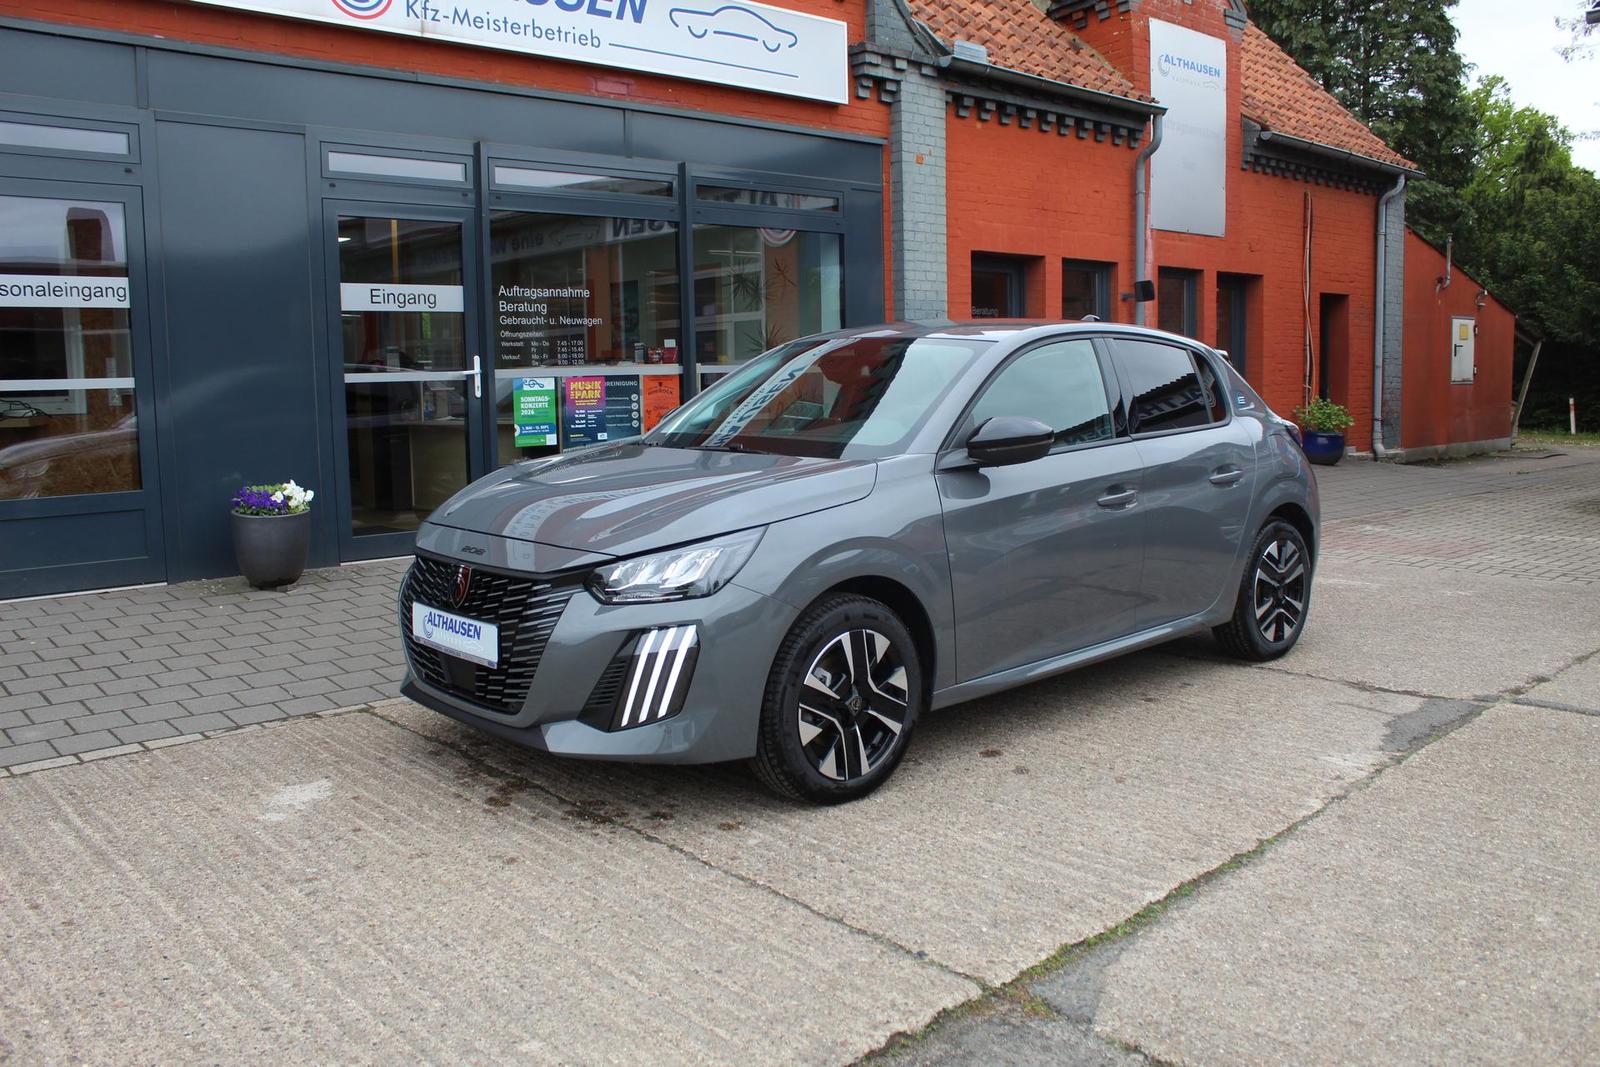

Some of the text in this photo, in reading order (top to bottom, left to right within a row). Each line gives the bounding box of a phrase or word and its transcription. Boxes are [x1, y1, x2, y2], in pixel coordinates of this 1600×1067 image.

[405, 0, 601, 48] Kfz-Meisterbetrieb
[1163, 54, 1221, 78] ALTHAUSEN
[0, 281, 128, 303] sonaleingang
[370, 288, 438, 309] Eingang
[498, 285, 591, 300] Auftragsannahme
[499, 301, 548, 315] Beratung
[499, 315, 547, 325] Gebraucht-
[559, 316, 603, 327] Neuwagen
[570, 380, 602, 390] MUSIK
[575, 390, 600, 399] PARK
[426, 611, 482, 640] ALTHAUSEN
